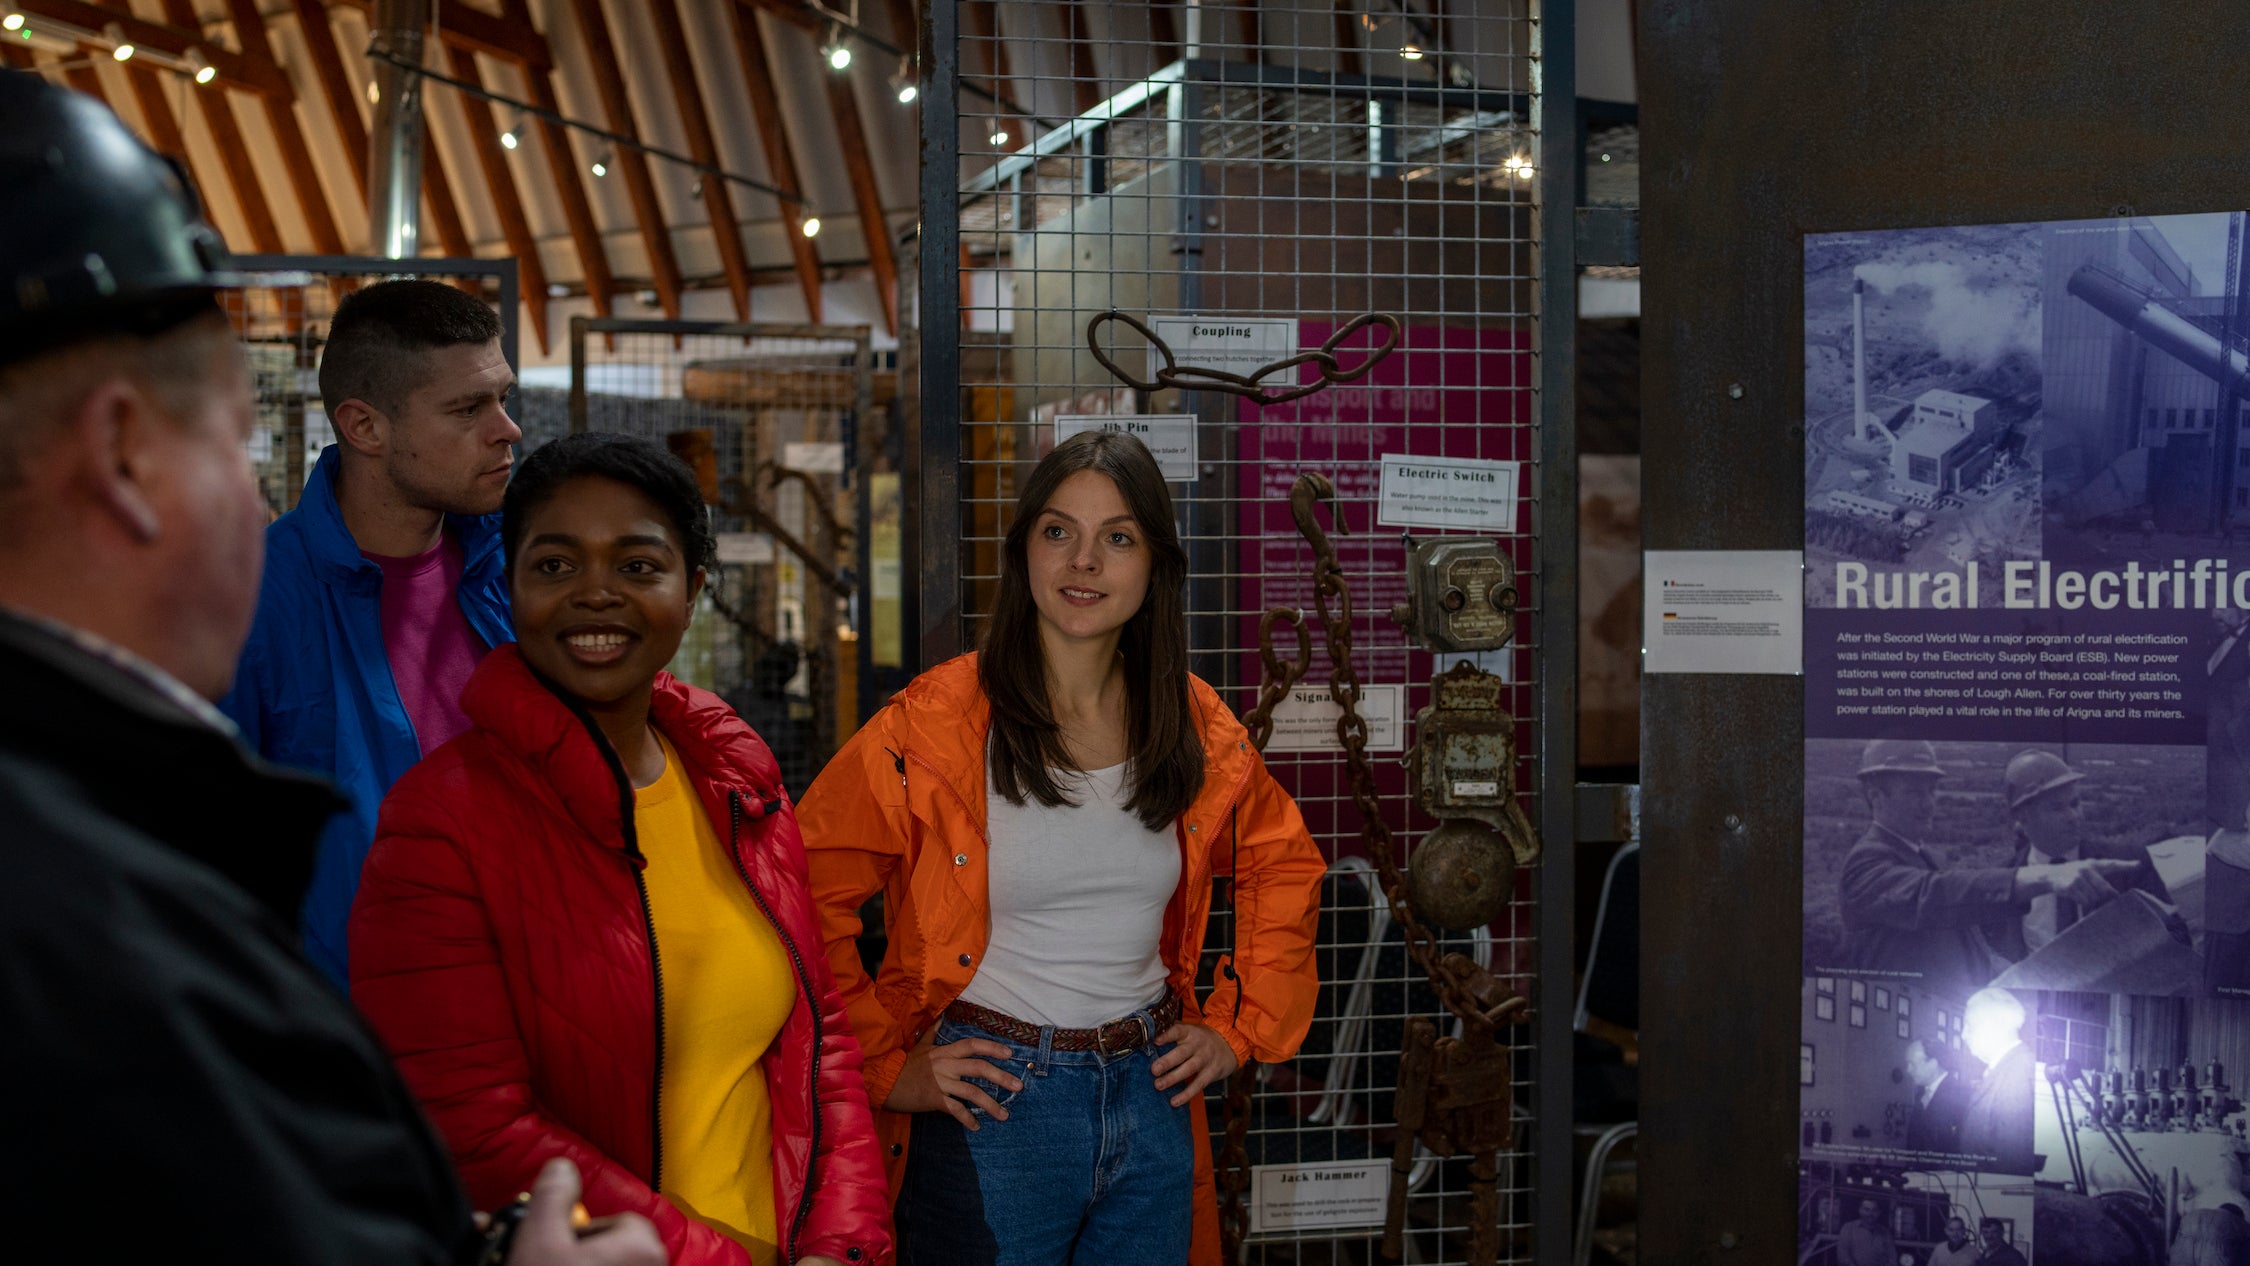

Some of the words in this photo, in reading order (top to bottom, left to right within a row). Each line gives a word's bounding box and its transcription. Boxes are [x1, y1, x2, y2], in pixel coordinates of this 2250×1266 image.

[1193, 326, 1251, 338] Coupling
[1128, 422, 1148, 432] Pin
[1311, 414, 1388, 445] Mines
[1399, 467, 1448, 480] Electric
[1454, 470, 1494, 482] Switch
[1836, 560, 1978, 610] Rural
[2004, 559, 2250, 610] Electrific
[1836, 632, 1862, 643] After
[1864, 632, 1881, 643] the
[1883, 632, 1924, 644] Second
[1926, 632, 1956, 644] World
[1959, 633, 1980, 644] War
[1983, 635, 1990, 644] a
[1992, 632, 2023, 646] major
[2026, 634, 2072, 646] program
[2074, 633, 2085, 644] of
[2088, 634, 2112, 644] rural
[2114, 634, 2188, 645] electrification
[1836, 652, 1858, 661] was
[1861, 650, 1903, 662] initiated
[1906, 651, 1920, 663] by
[1922, 650, 1940, 662] the
[1943, 650, 1996, 664] Electricity
[1998, 651, 2036, 664] Supply
[2040, 652, 2074, 662] Board
[2076, 652, 2110, 664] (ESB).
[2114, 652, 2140, 662] New
[2143, 654, 2180, 665] power
[1836, 668, 1878, 679] stations
[1881, 671, 1908, 679] were
[1910, 669, 1974, 680] constructed
[1977, 669, 1998, 680] and
[2000, 671, 2022, 680] one
[2024, 669, 2036, 680] of
[2082, 670, 2136, 682] coal-fired
[2138, 672, 2180, 683] station,
[1295, 692, 1331, 704] Signa
[1836, 687, 1858, 696] was
[1861, 686, 1884, 696] built
[1886, 688, 1901, 697] on
[1904, 686, 1921, 698] the
[1924, 687, 1960, 698] shores
[1962, 687, 1974, 698] of
[1977, 688, 2012, 700] Lough
[2014, 688, 2044, 698] Allen.
[2048, 688, 2067, 699] For
[2070, 690, 2094, 700] over
[2098, 689, 2126, 702] thirty
[2129, 692, 2160, 702] years
[2163, 690, 2182, 700] the
[1836, 706, 1869, 716] power
[1871, 704, 1906, 716] station
[1908, 704, 1944, 717] played
[1946, 707, 1953, 716] a
[1956, 706, 1977, 716] vital
[1980, 706, 2000, 716] role
[2002, 706, 2012, 716] in
[2014, 706, 2032, 716] the
[2034, 706, 2050, 716] life
[2052, 706, 2064, 717] of
[2066, 706, 2102, 720] Arigna
[2104, 708, 2125, 718] and
[2128, 708, 2141, 718] its
[2144, 708, 2185, 719] miners.
[1280, 1172, 1308, 1183] Jack
[1315, 1172, 1367, 1181] Hammer
